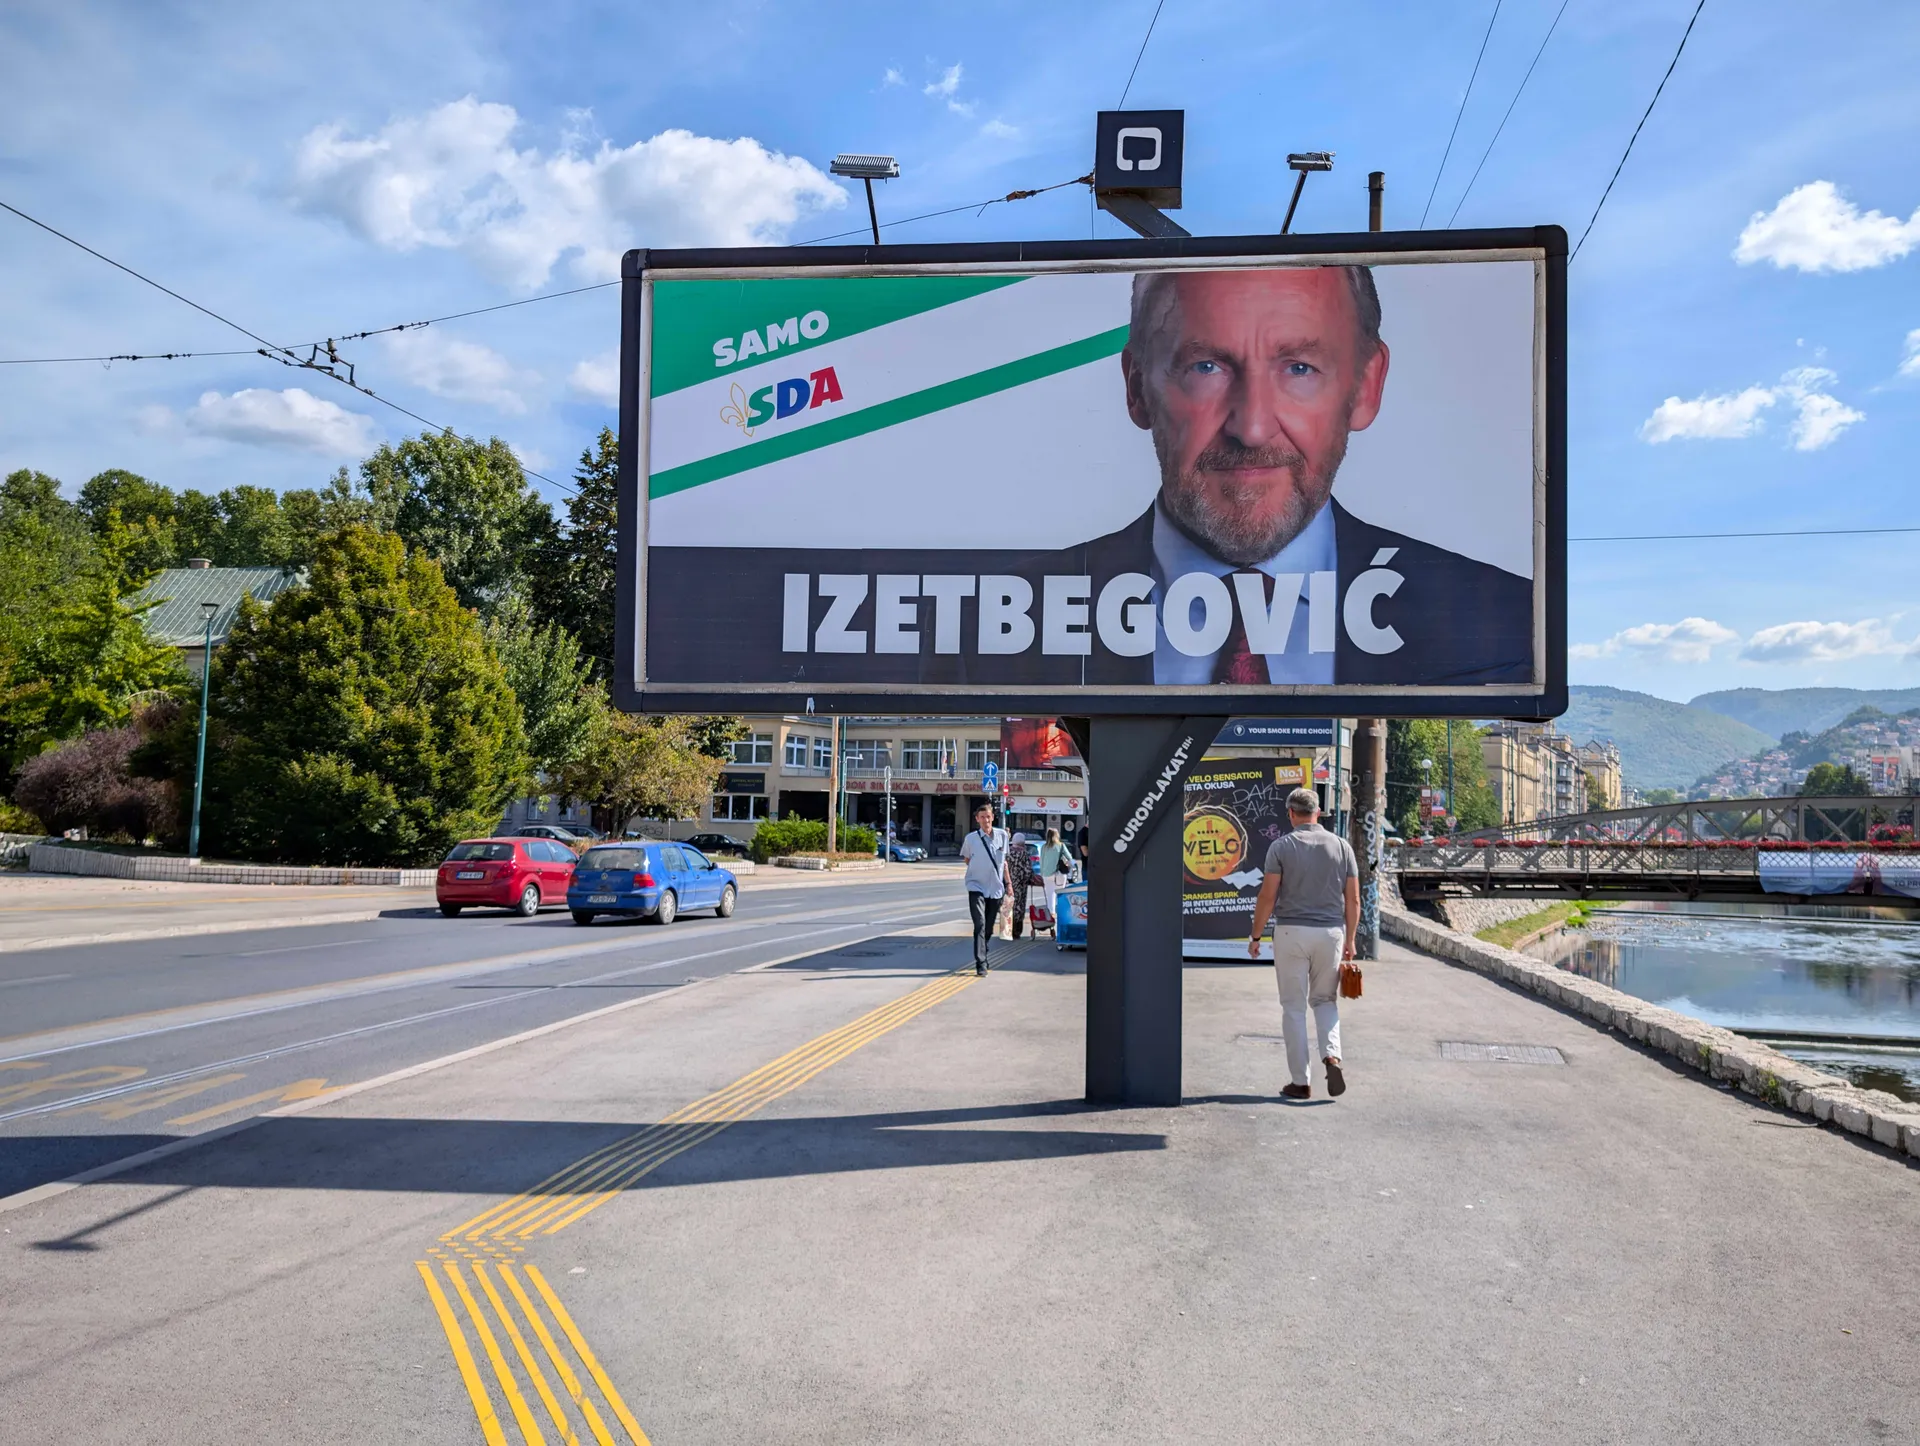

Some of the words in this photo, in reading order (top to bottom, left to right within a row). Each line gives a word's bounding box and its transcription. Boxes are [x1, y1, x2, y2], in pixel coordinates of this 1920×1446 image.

[713, 310, 829, 367] SAMO
[746, 366, 844, 428] SDA
[782, 548, 1405, 657] IZETBEGOVIĆ
[1189, 774, 1212, 783] VELO
[1213, 771, 1263, 782] SENSATION
[1279, 767, 1304, 778] No.1
[870, 781, 921, 792] SINIKATA
[1204, 781, 1235, 790] OKUSA
[1184, 838, 1239, 856] VELO
[1214, 891, 1239, 899] SPARK
[1193, 898, 1236, 907] INTENZIVAN
[1194, 906, 1225, 914] CVIJETA
